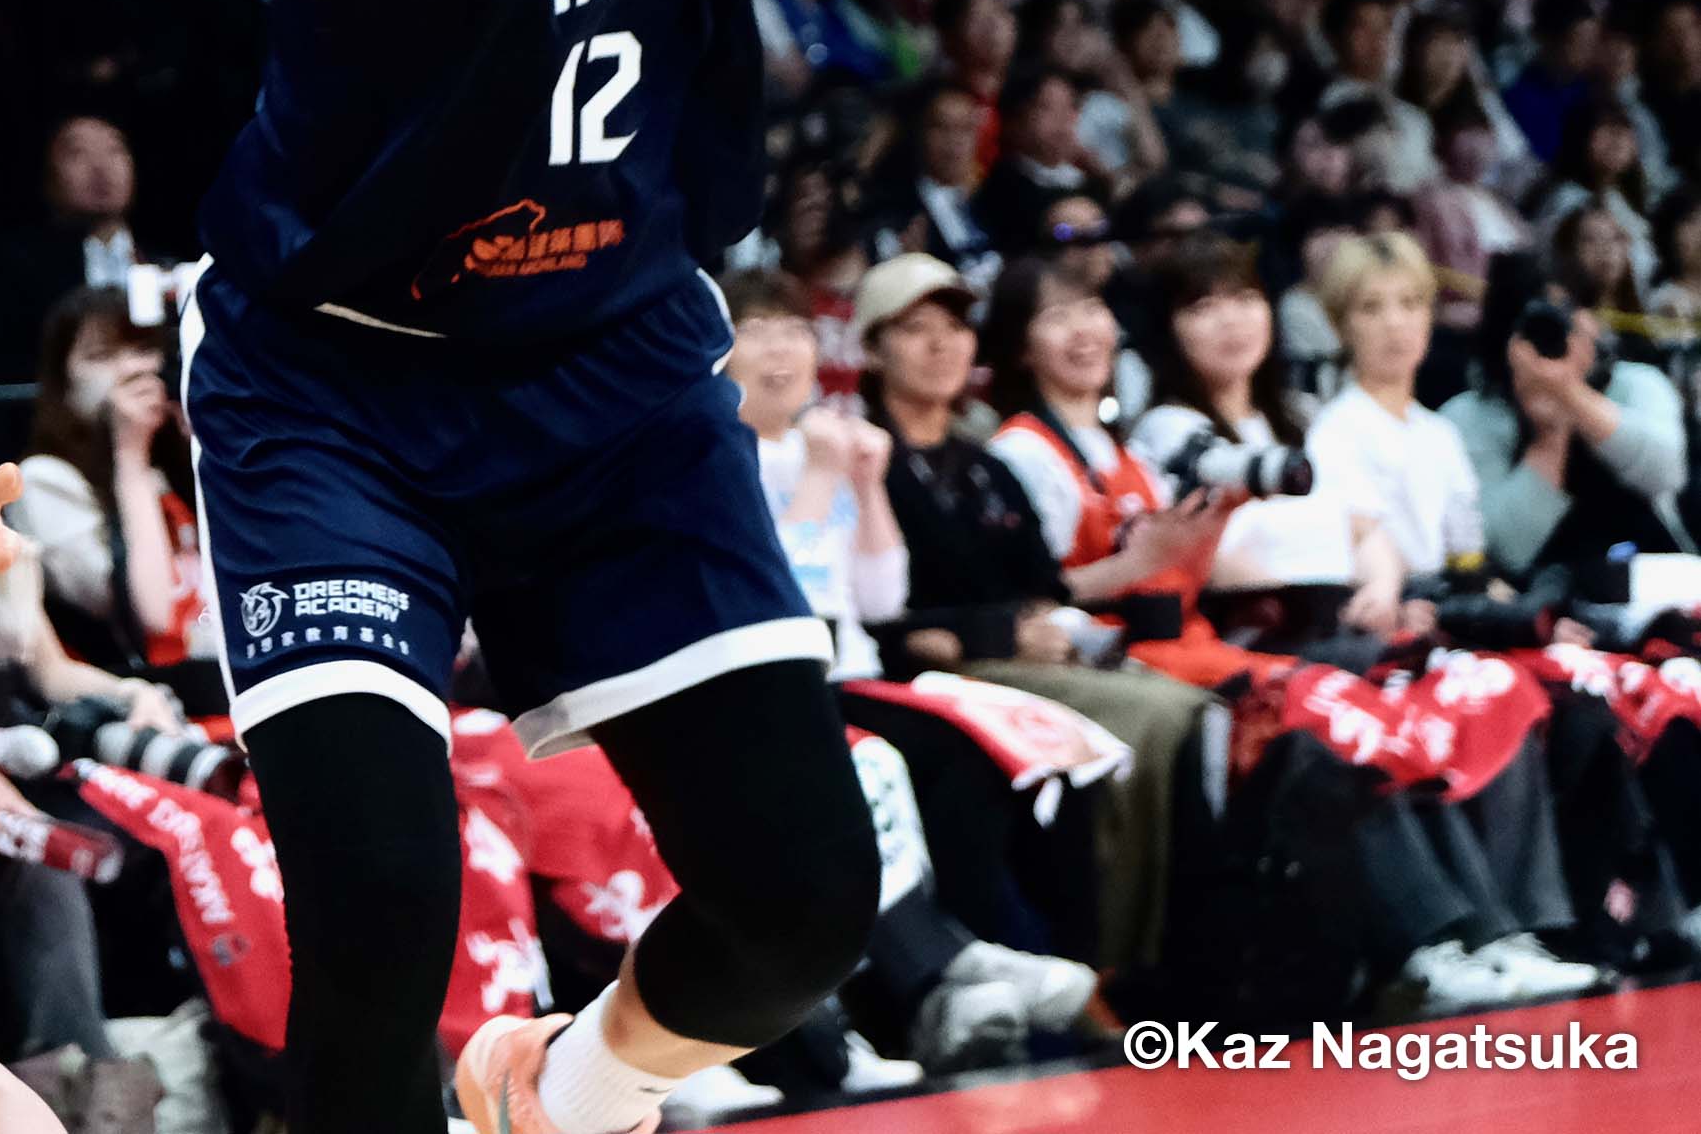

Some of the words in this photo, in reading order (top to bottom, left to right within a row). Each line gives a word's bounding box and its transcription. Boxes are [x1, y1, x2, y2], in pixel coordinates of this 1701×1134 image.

[548, 30, 642, 166] 12
[292, 579, 410, 611] DREAMERS
[294, 596, 401, 623] ACADEMY
